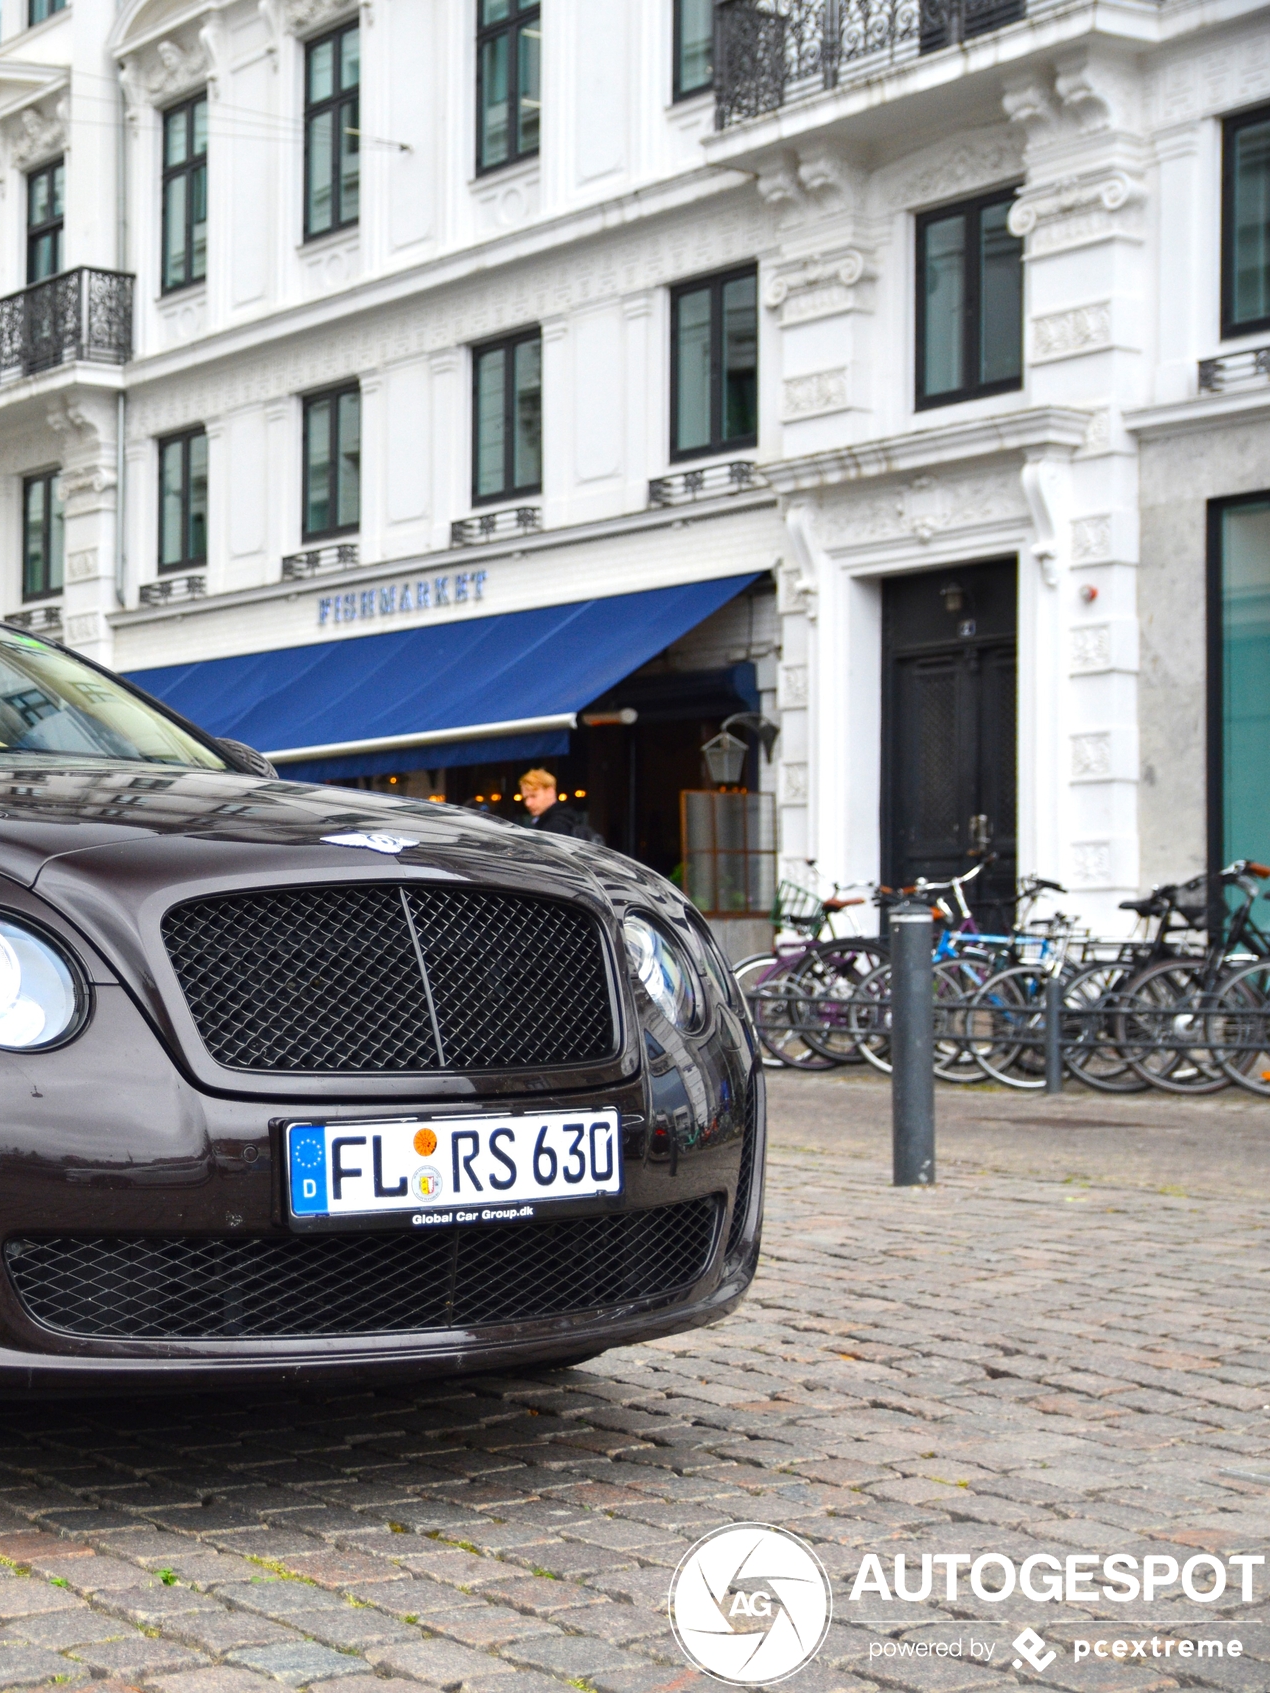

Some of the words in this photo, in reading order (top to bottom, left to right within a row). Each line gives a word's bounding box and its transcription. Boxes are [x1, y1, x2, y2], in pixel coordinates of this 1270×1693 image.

[319, 571, 487, 625] FISHMARKET
[332, 1135, 408, 1200] FL
[451, 1128, 517, 1193] RS
[533, 1122, 613, 1186] 630
[303, 1178, 317, 1199] D
[412, 1212, 453, 1225] Global
[456, 1212, 478, 1222] Car
[481, 1206, 534, 1219] Group.dk
